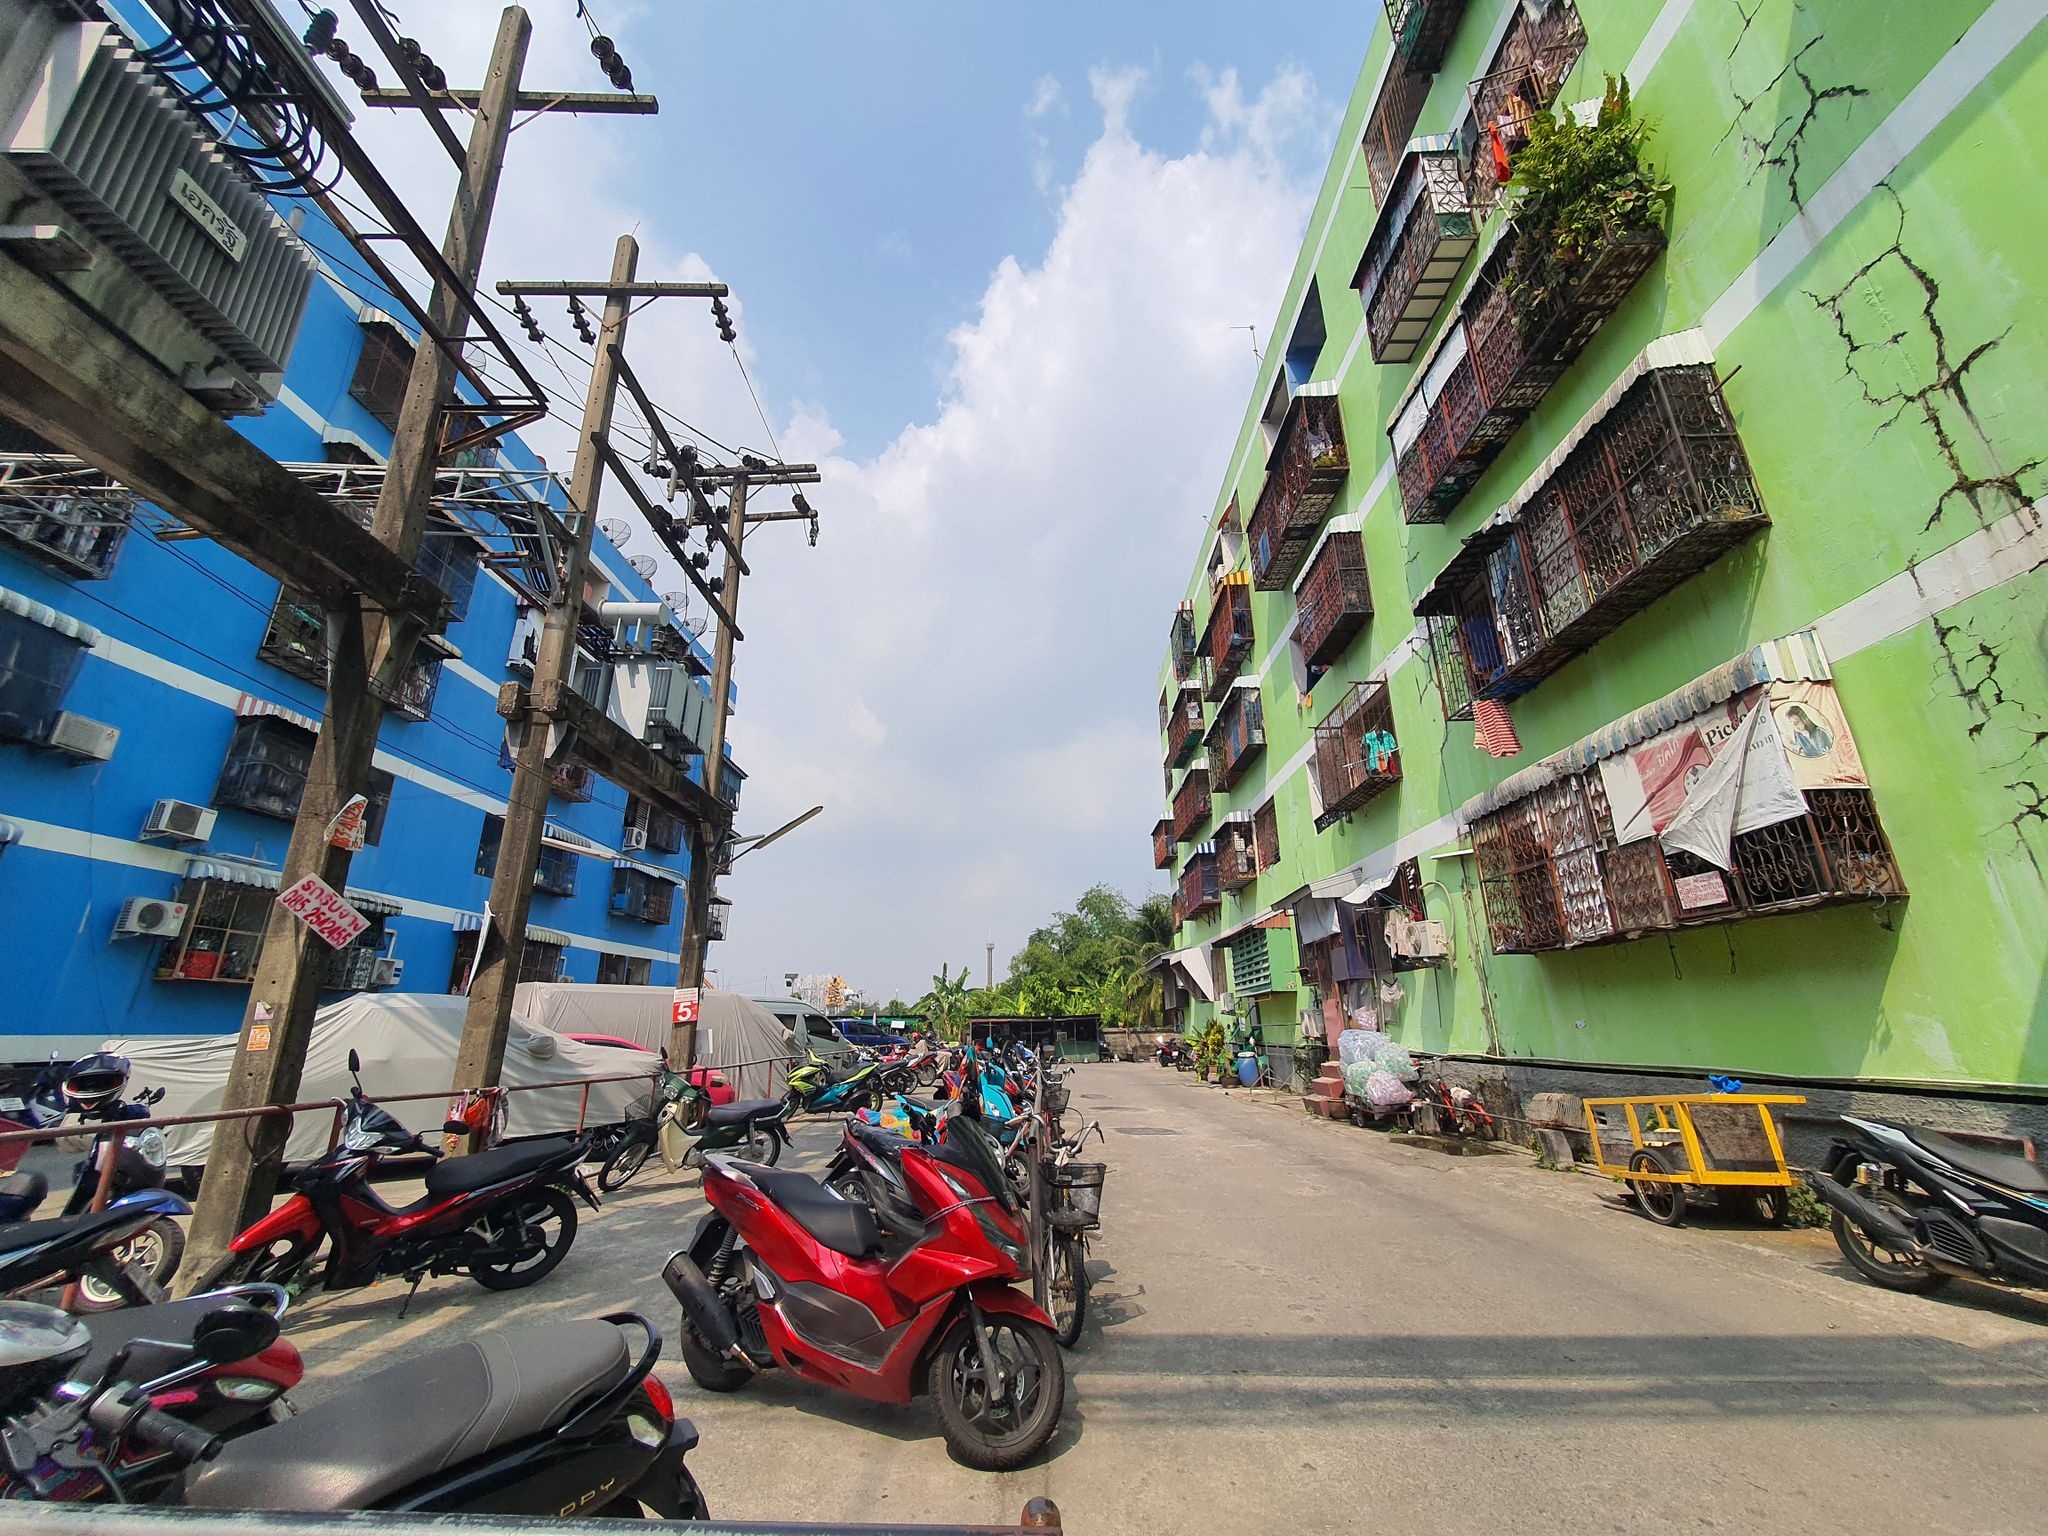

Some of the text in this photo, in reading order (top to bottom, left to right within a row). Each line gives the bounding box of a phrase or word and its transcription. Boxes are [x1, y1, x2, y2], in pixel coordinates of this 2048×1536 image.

[181, 183, 239, 252] เอกรัฐ
[677, 1001, 692, 1021] 5
